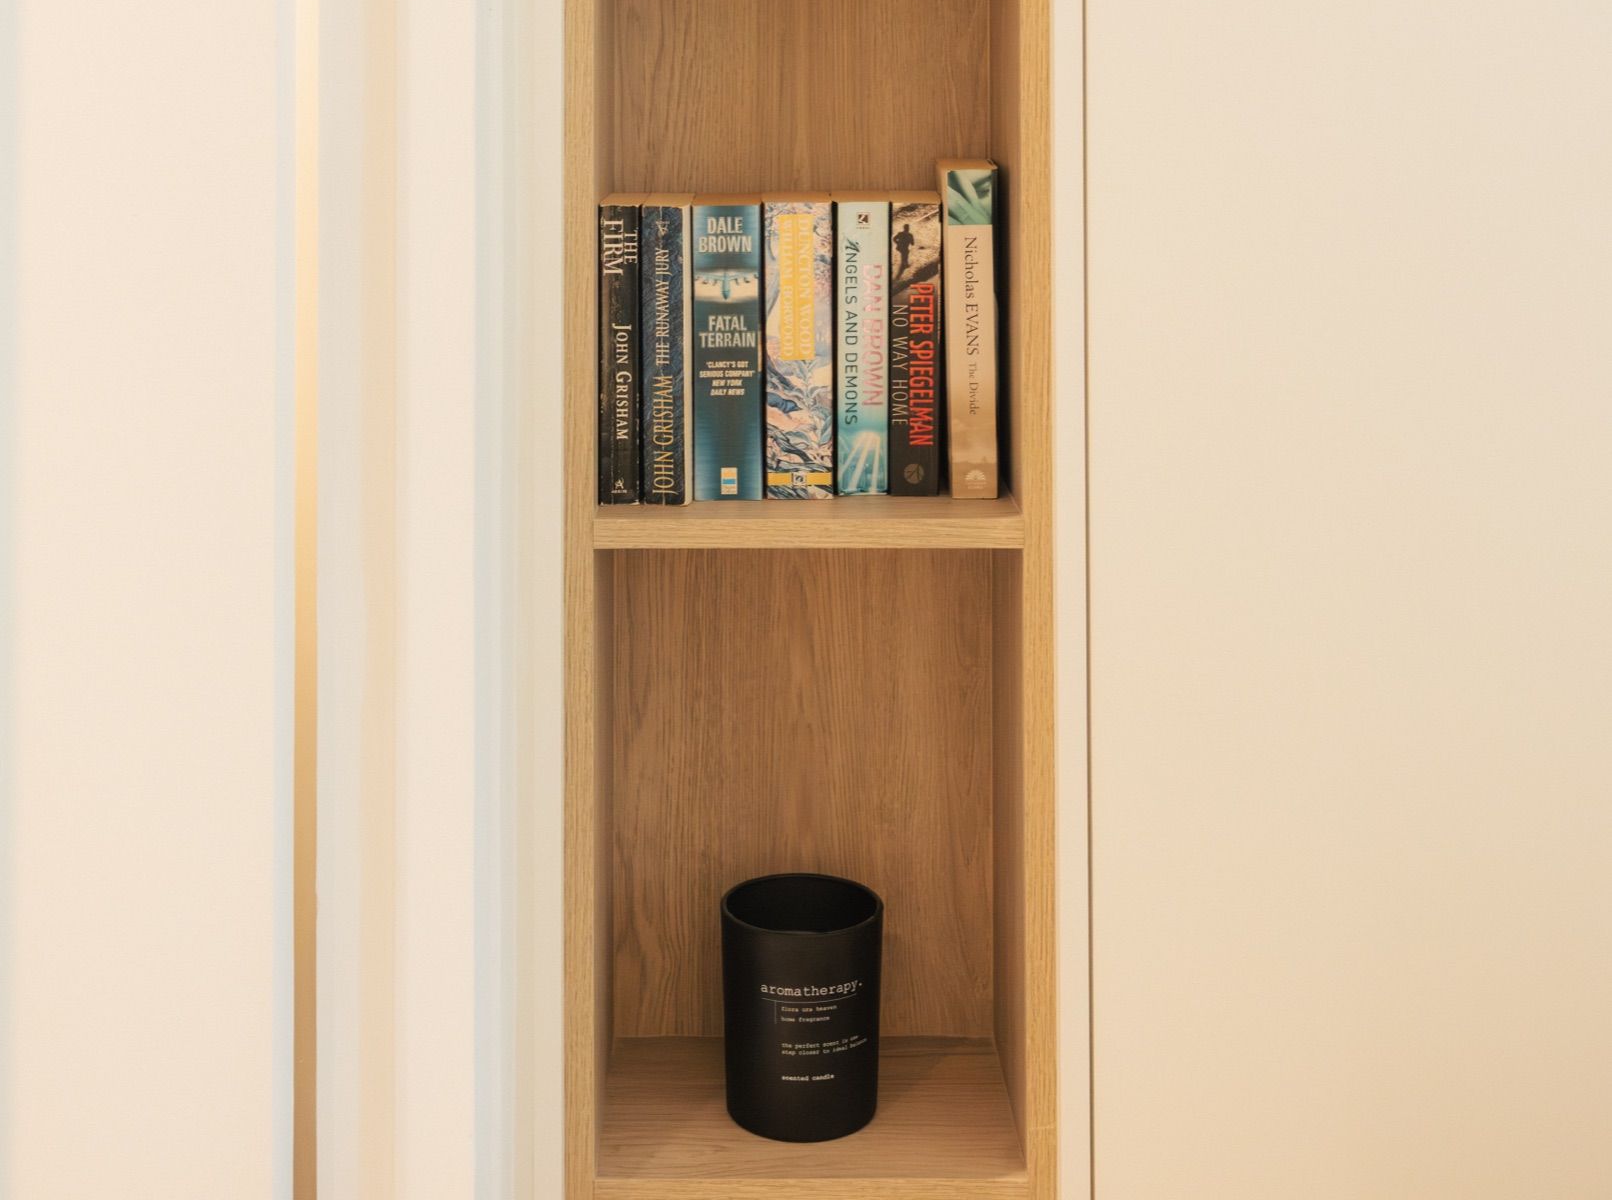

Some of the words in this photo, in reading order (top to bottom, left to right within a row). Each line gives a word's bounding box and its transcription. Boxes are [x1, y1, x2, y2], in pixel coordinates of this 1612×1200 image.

[699, 236, 752, 253] BROWN
[707, 216, 743, 234] DALE
[603, 219, 624, 276] FIRM
[624, 230, 638, 265] THE
[655, 247, 672, 275] JURY
[844, 237, 860, 304] ANGELS
[964, 237, 979, 299] Nicholas
[863, 264, 883, 312] DAN
[655, 280, 670, 337] RUNAWAY
[708, 315, 747, 332] FATAL
[845, 311, 858, 345] AND
[892, 304, 909, 327] NO
[910, 283, 934, 334] PETER
[699, 332, 756, 348] TERRAIN
[965, 304, 979, 356] EVANS
[655, 342, 671, 366] THE
[862, 319, 884, 406] BROWN
[892, 336, 908, 370] WAY
[710, 388, 727, 396] DAILY
[845, 352, 858, 425] DEMONS
[892, 379, 908, 425] HOME
[909, 340, 934, 445] SPIEGELMAN
[969, 381, 980, 416] Divide
[653, 375, 674, 446] GRISHAM
[653, 451, 678, 495] JOHN
[760, 980, 862, 996] aromatherapy.
